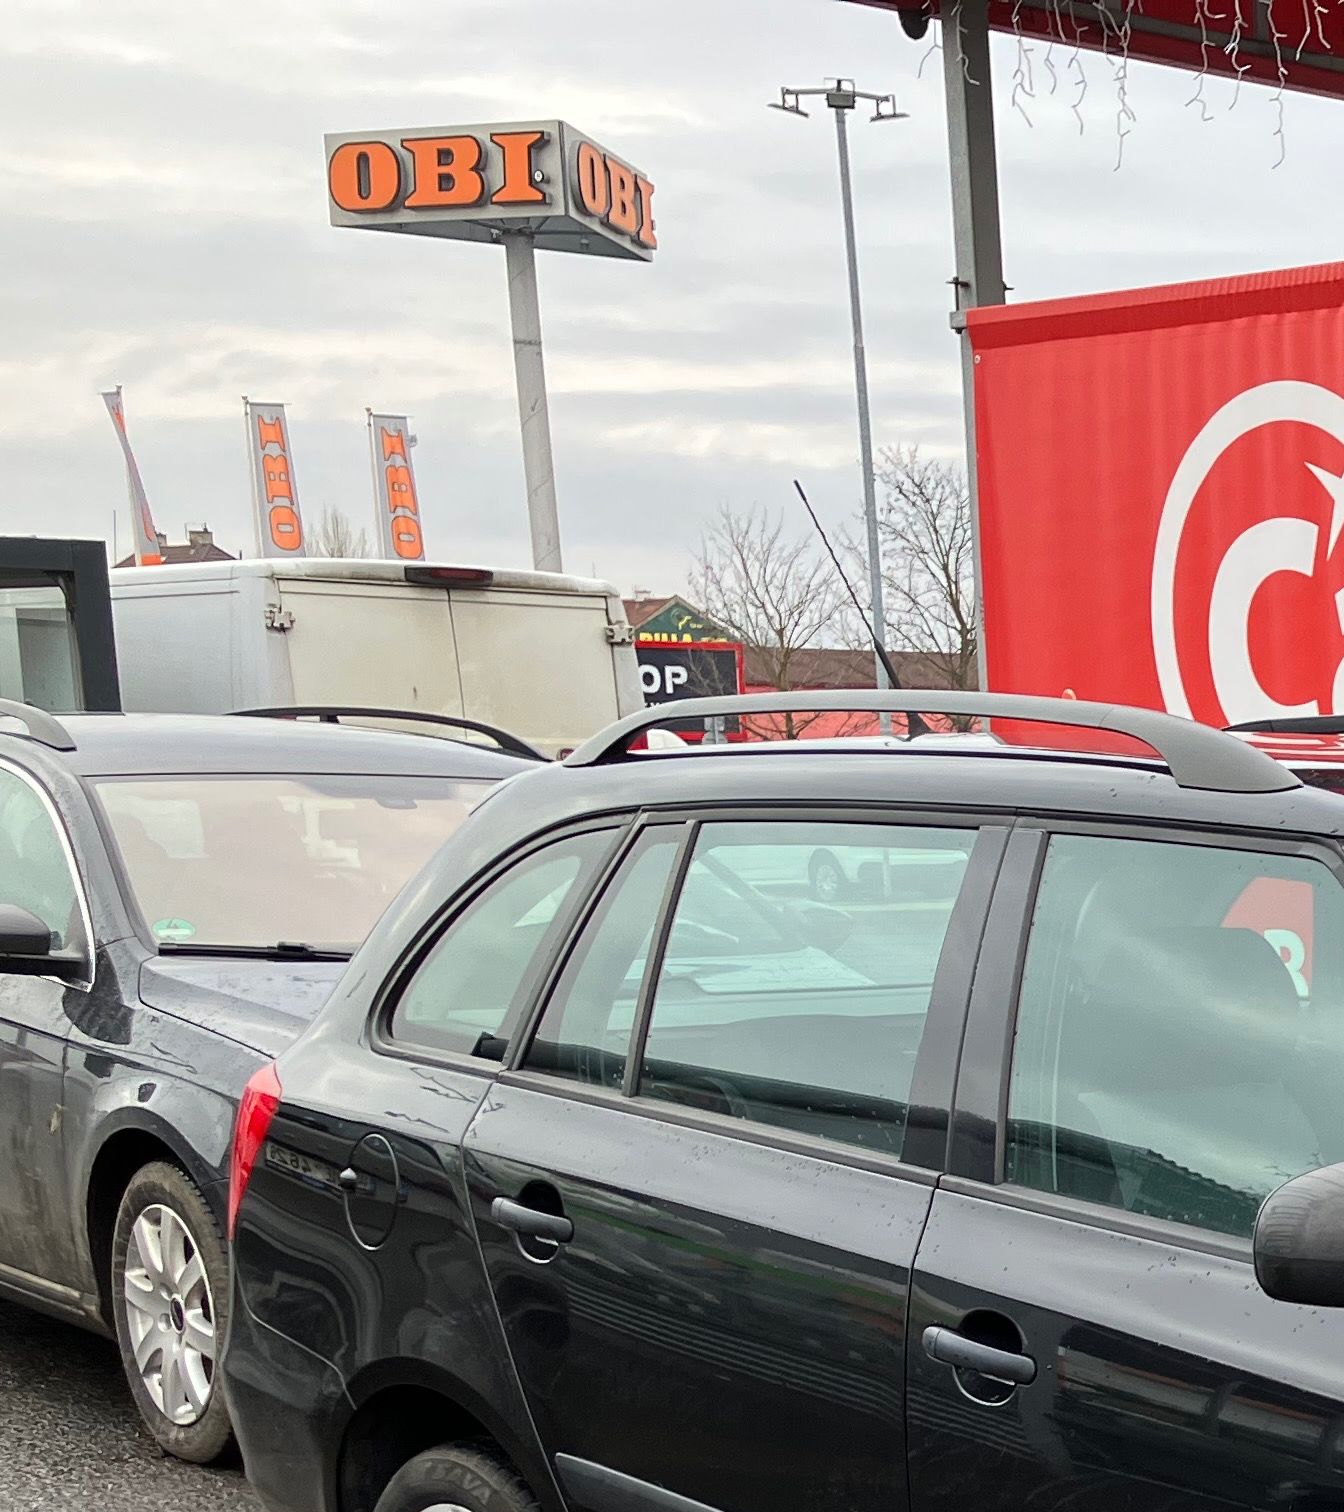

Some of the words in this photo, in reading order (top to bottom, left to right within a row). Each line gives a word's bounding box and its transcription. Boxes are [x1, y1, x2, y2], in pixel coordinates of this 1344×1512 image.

[329, 131, 549, 213] OBI
[576, 141, 657, 250] OBI
[258, 414, 302, 551] OBI
[380, 426, 424, 560] OBI
